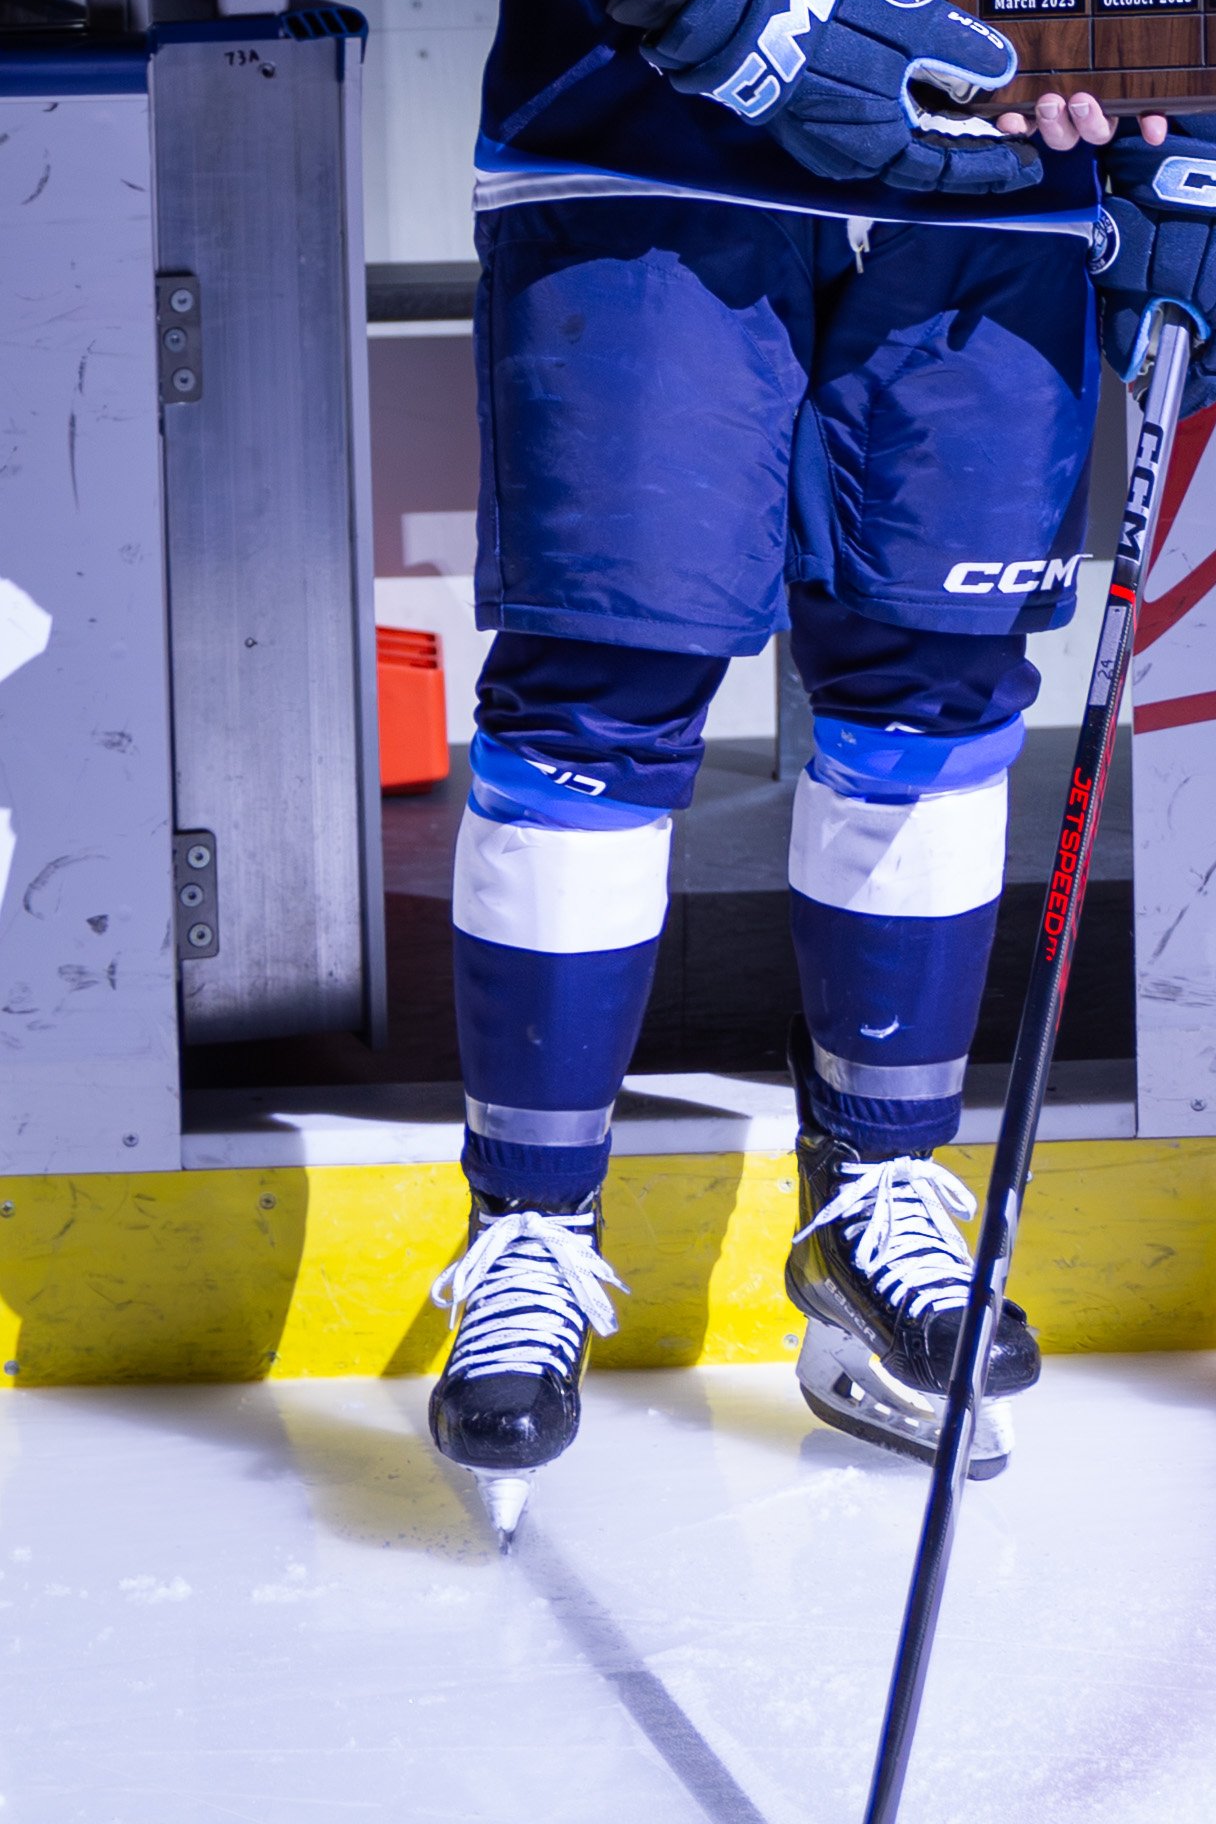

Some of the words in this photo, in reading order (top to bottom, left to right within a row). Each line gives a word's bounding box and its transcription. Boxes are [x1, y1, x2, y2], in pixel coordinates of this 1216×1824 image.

[948, 11, 1005, 50] CCM
[224, 49, 260, 67] 73A
[1117, 421, 1165, 566] CCM
[943, 552, 1094, 594] CCM
[1044, 766, 1092, 937] JETSPEED
